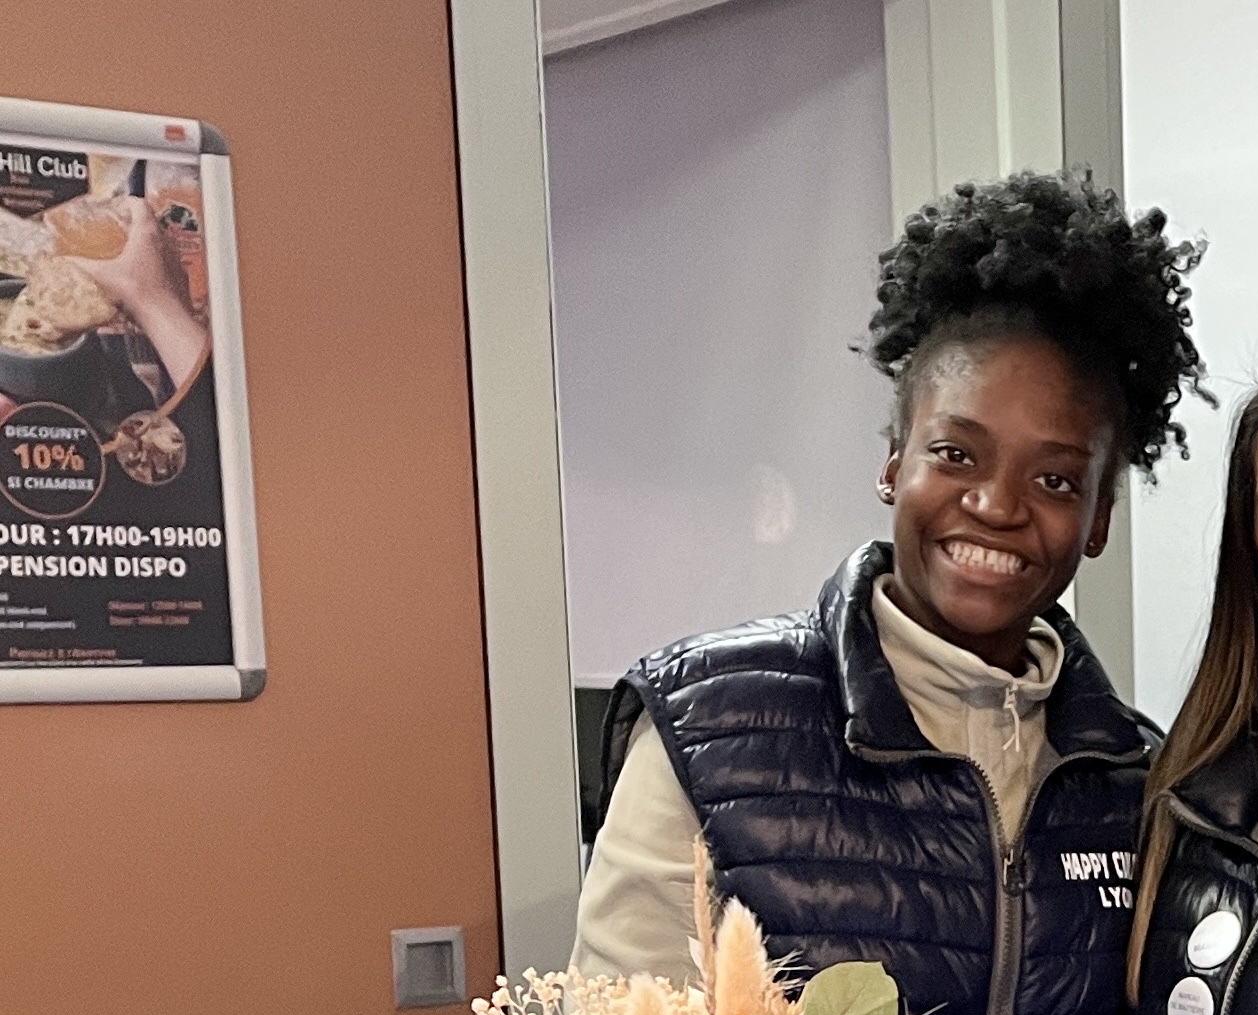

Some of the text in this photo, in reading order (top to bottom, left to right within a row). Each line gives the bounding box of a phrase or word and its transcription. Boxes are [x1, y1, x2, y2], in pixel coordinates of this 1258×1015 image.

[37, 156, 87, 179] Club
[13, 443, 85, 471] 10%
[67, 525, 221, 547] 17H00-19H00
[115, 557, 186, 577] DISPO
[1061, 852, 1110, 881] HAPPY
[1099, 886, 1133, 909] LYO
